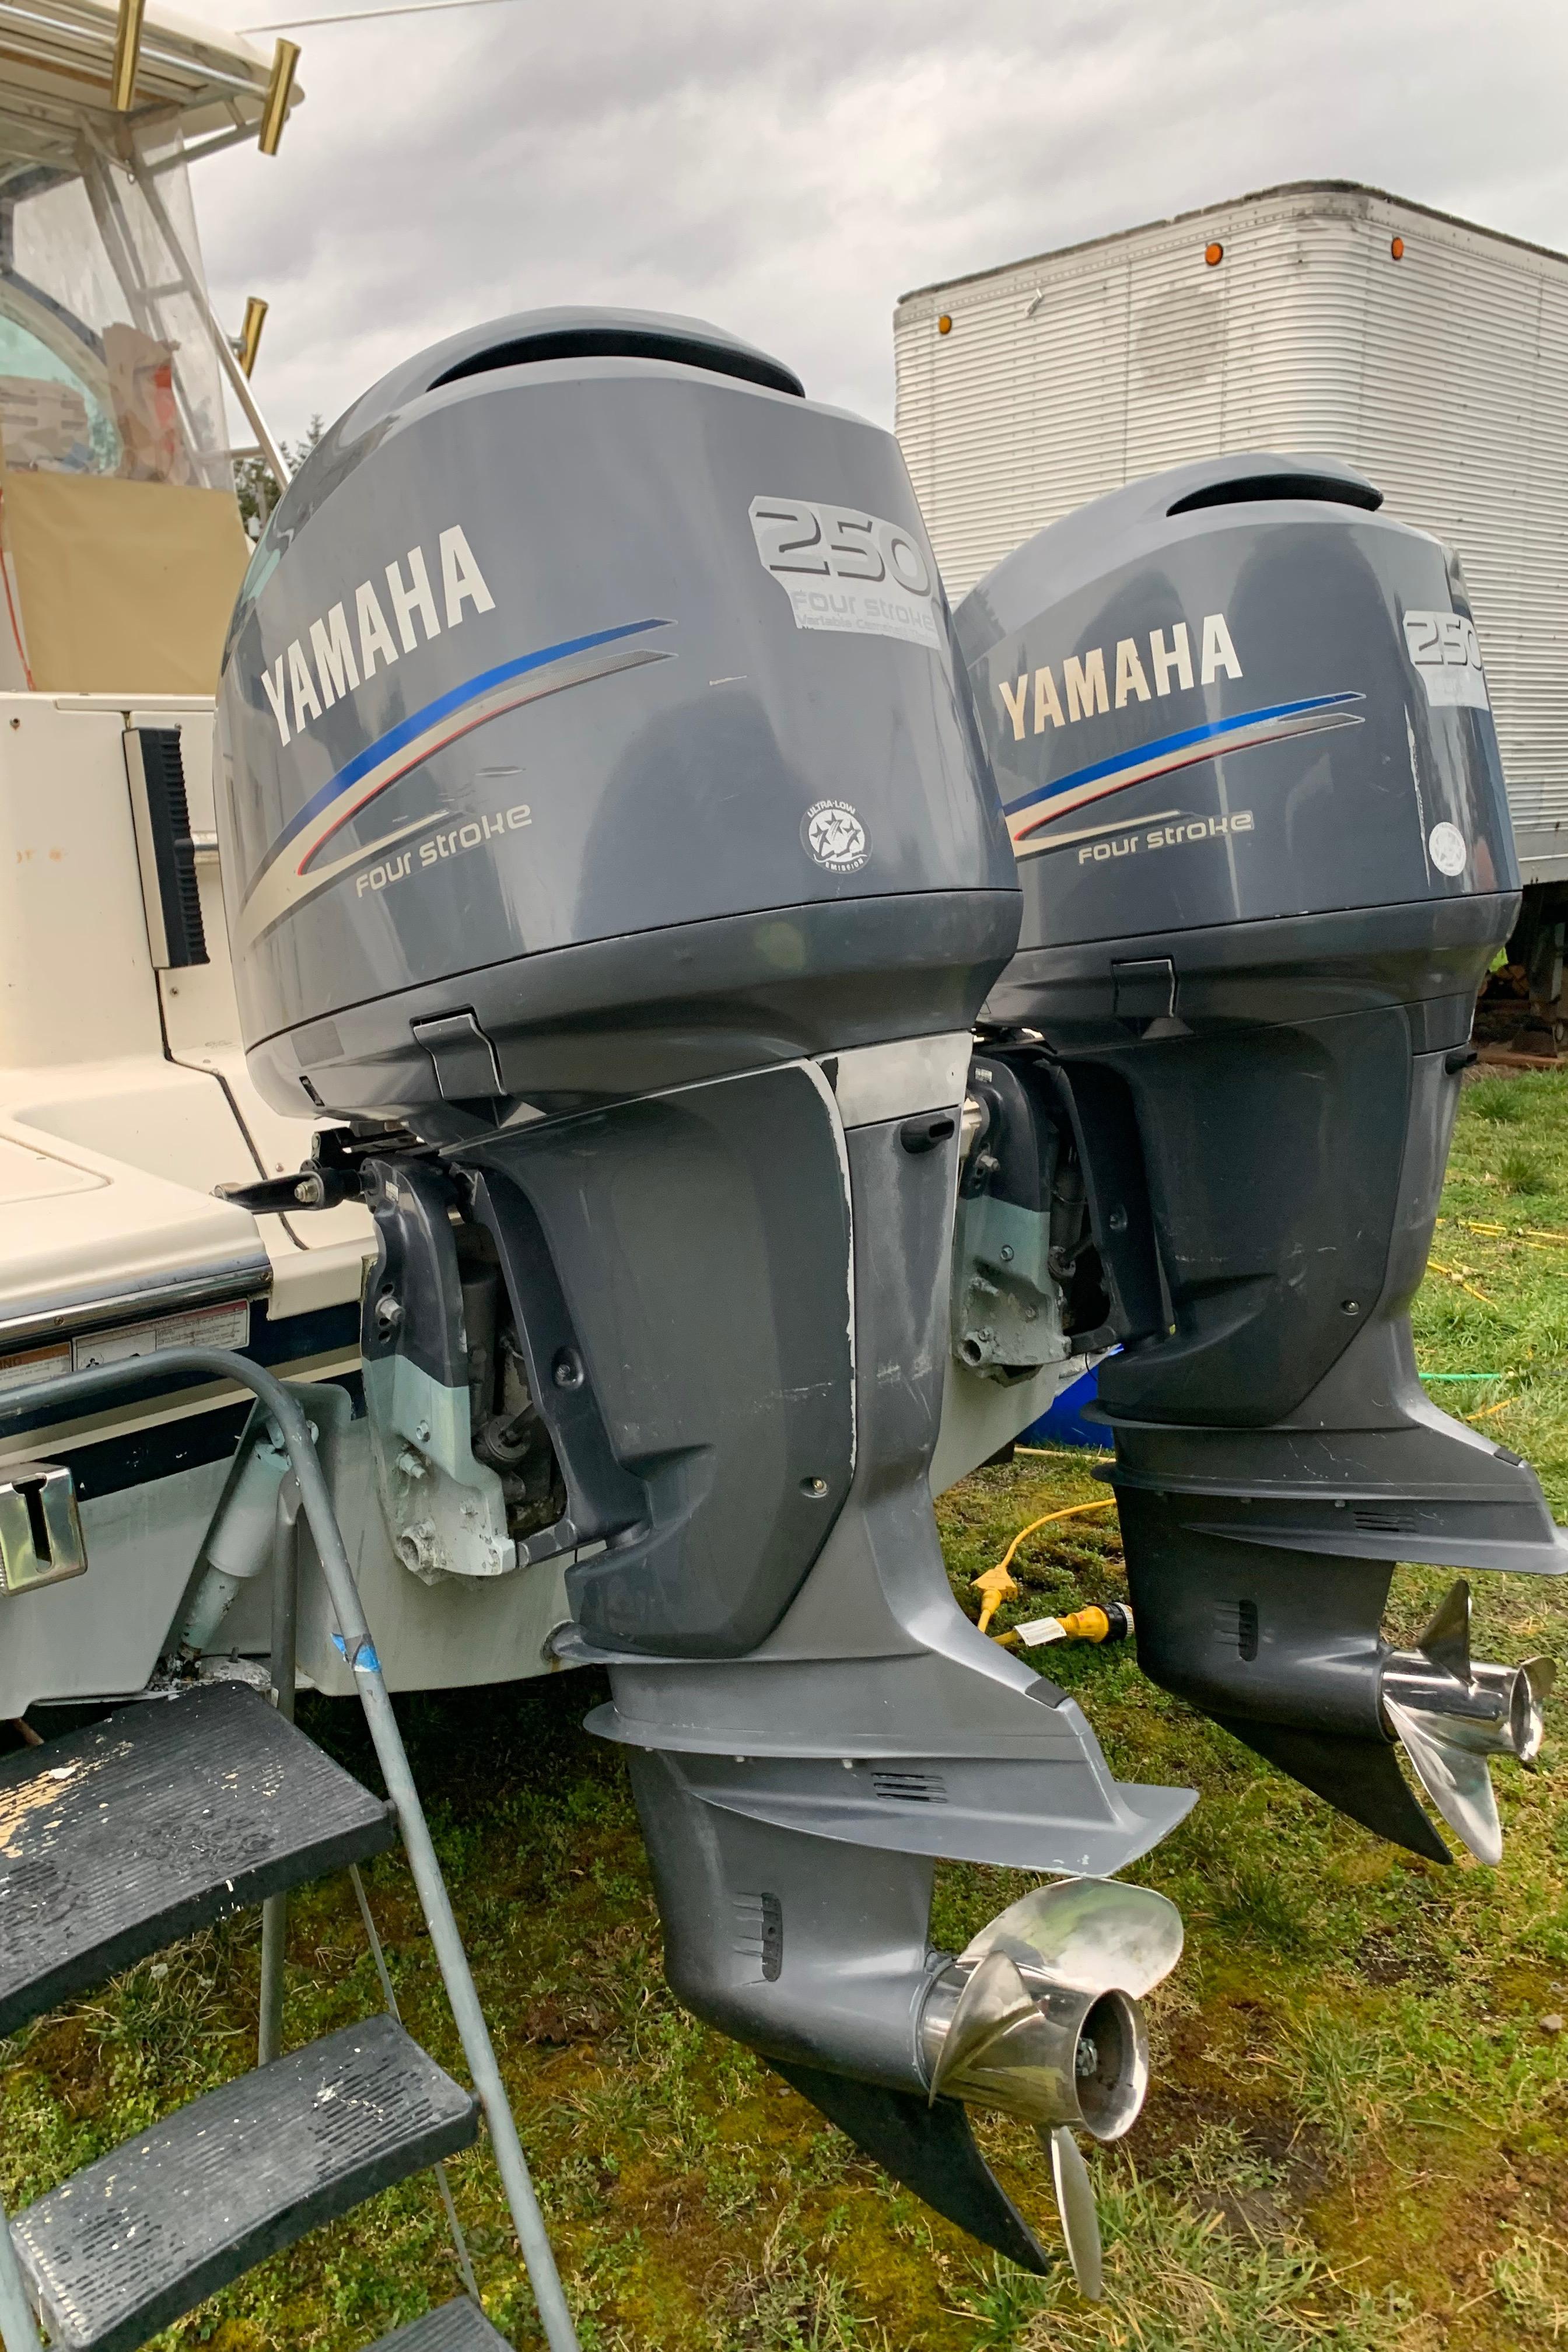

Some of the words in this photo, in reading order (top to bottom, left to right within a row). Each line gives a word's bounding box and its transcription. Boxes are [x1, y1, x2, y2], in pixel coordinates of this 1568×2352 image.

[754, 500, 932, 597] 250
[261, 524, 496, 747] YAMAHA
[999, 612, 1244, 741] YAMAHA
[1406, 614, 1483, 671] 250
